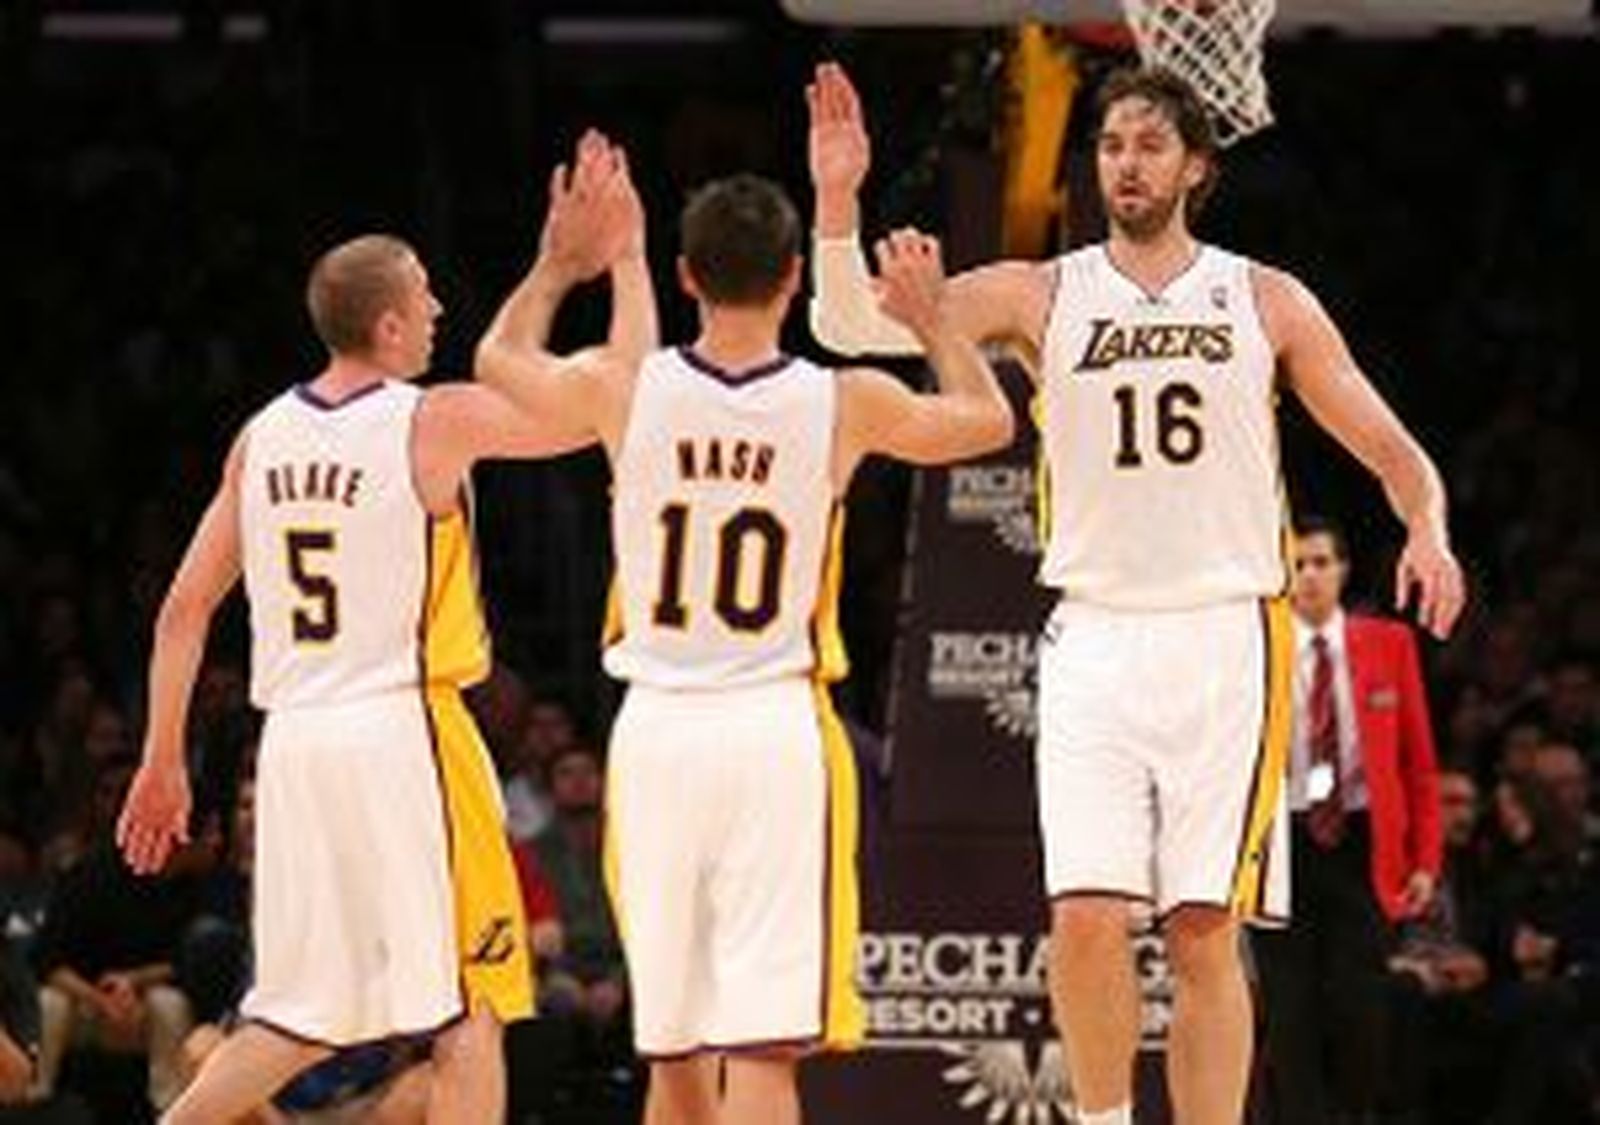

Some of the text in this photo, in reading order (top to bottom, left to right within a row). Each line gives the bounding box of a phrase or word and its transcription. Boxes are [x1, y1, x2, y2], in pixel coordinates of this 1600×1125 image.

[1073, 318, 1234, 373] LAKERS
[1113, 382, 1205, 468] 16
[267, 462, 363, 508] BLAKE
[676, 438, 776, 484] NASH
[284, 529, 341, 642] 5
[651, 501, 788, 634] 10
[866, 999, 1014, 1033] ESORT
